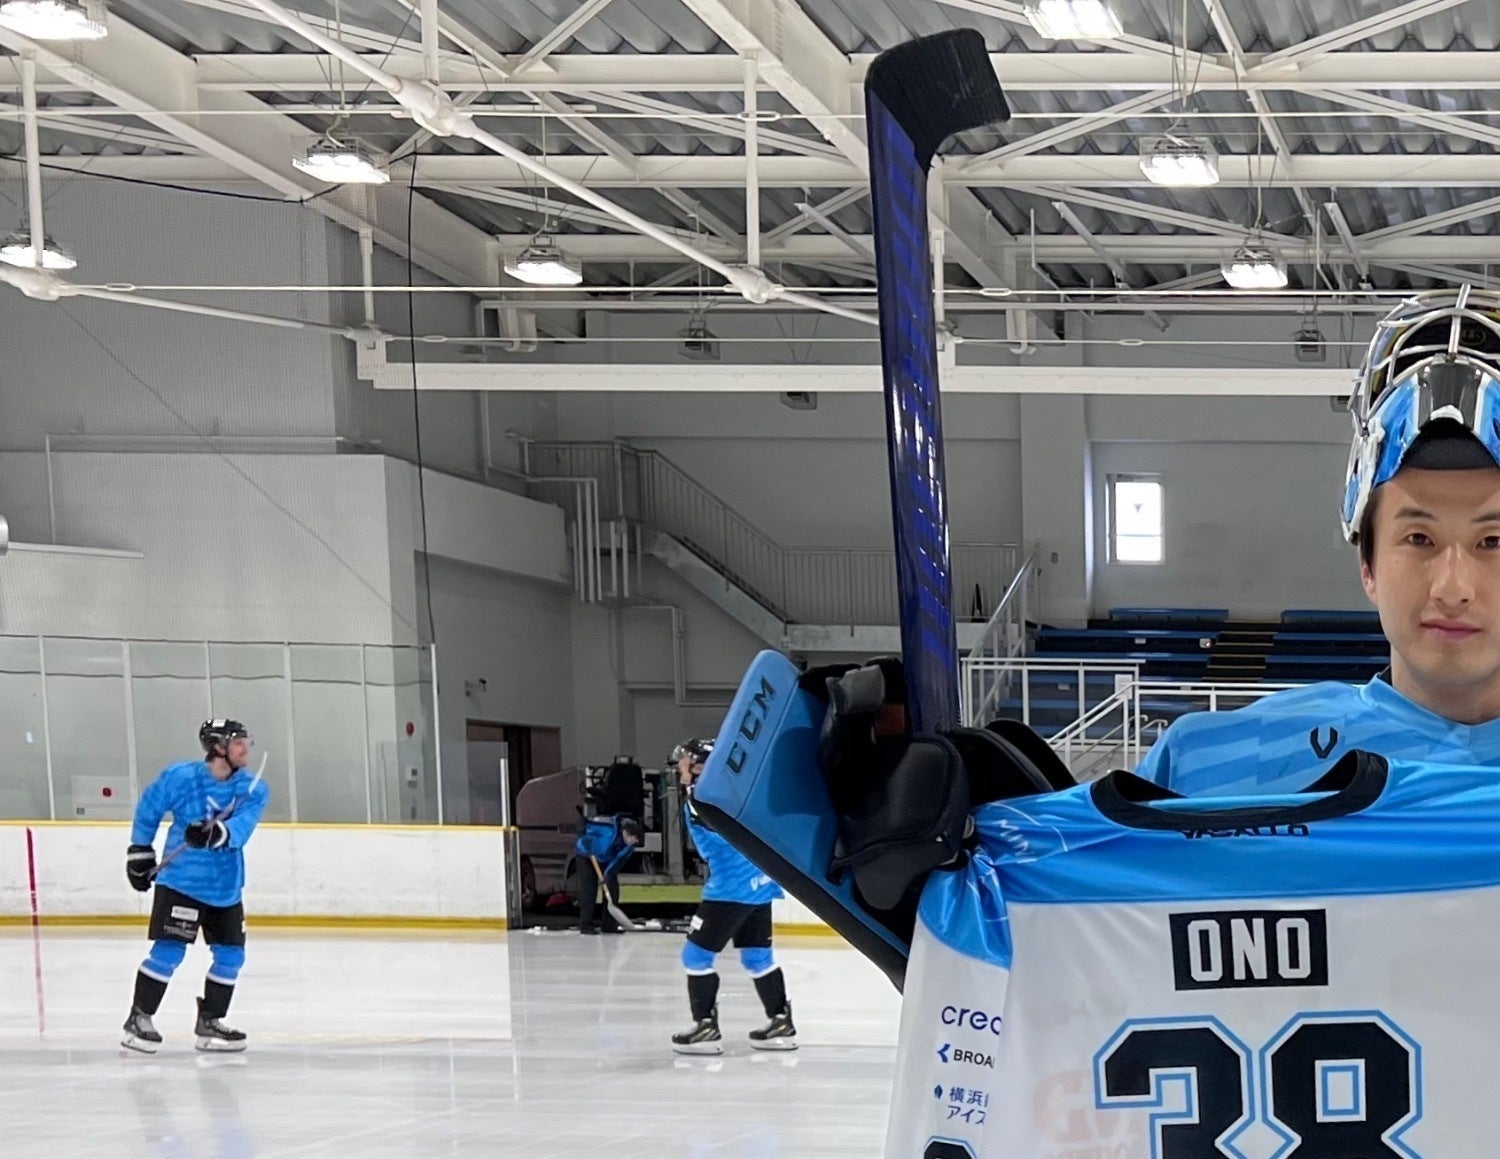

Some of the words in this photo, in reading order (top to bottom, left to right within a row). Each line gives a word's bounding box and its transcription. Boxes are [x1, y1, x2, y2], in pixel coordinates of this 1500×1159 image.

[726, 676, 775, 774] CCM
[1187, 917, 1311, 982] ONO
[953, 1048, 996, 1069] BROA
[949, 1086, 989, 1108] 横浜
